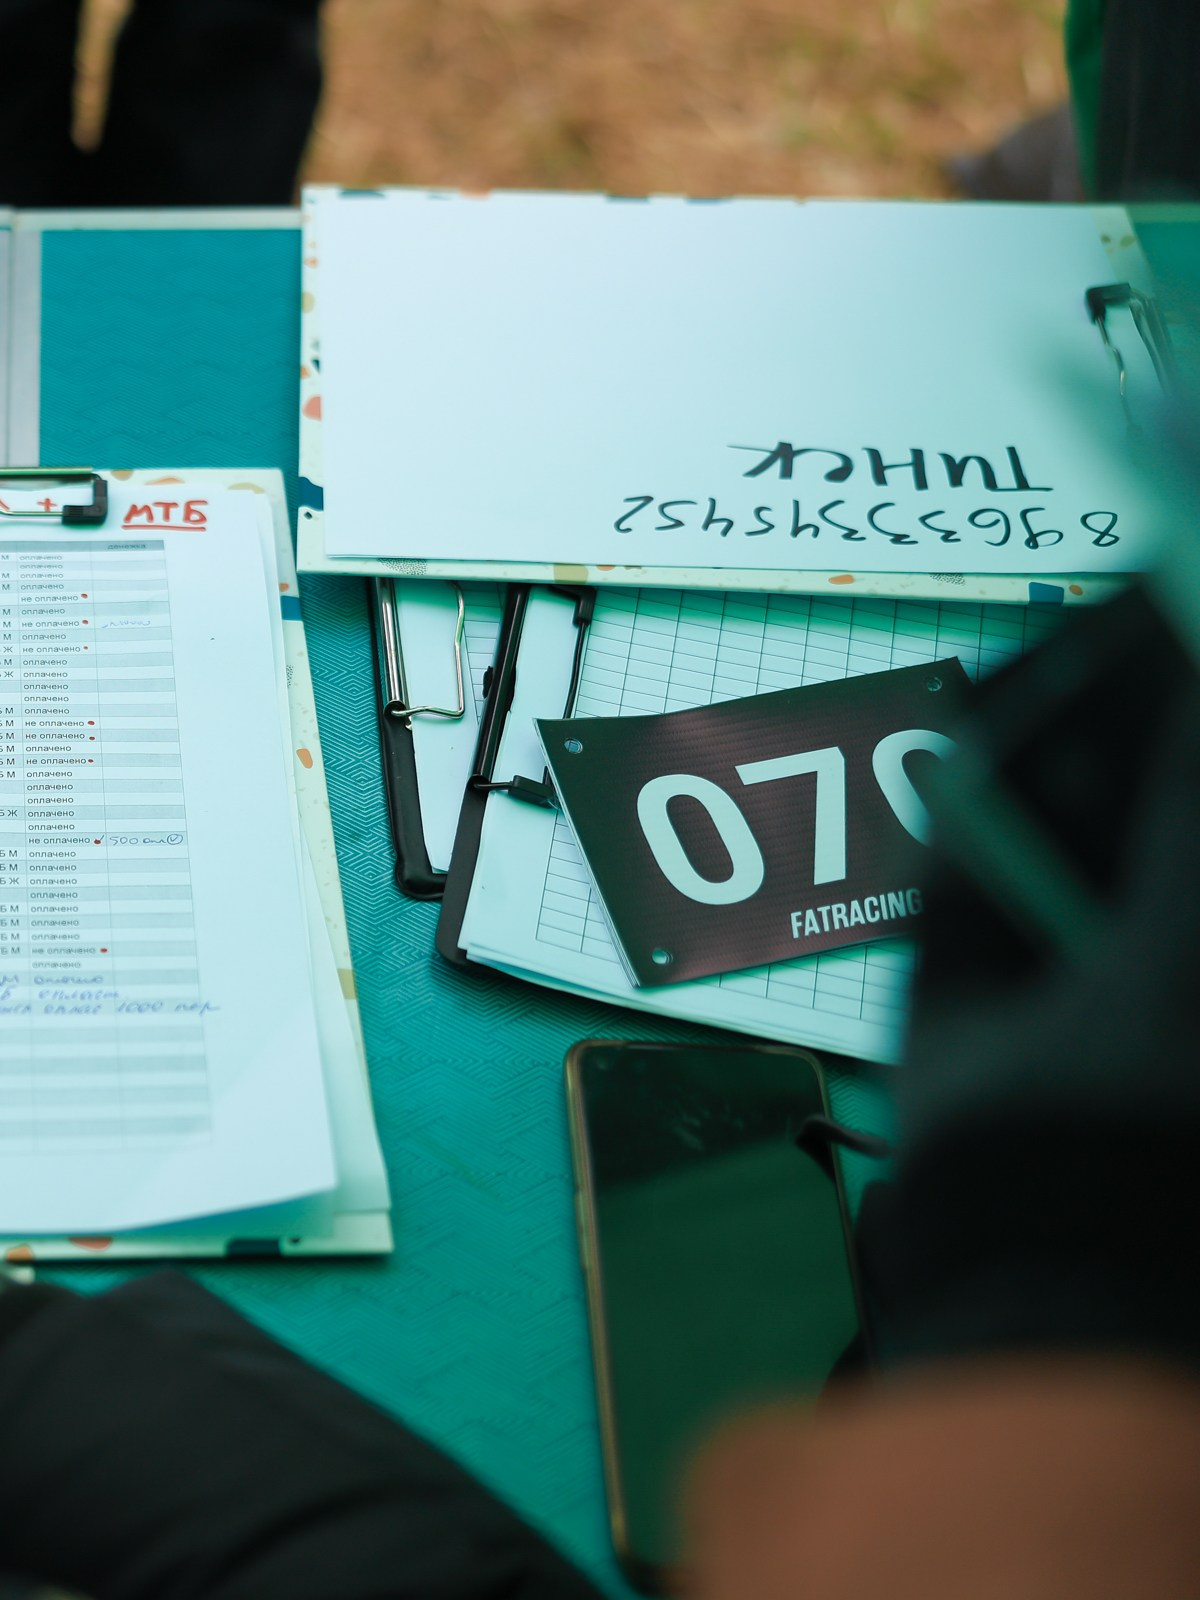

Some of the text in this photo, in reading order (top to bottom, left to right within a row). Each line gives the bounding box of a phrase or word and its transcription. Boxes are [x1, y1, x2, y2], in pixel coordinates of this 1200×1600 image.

[123, 500, 208, 523] МТБ
[9, 877, 19, 885] Ж
[790, 888, 924, 939] FATRACING
